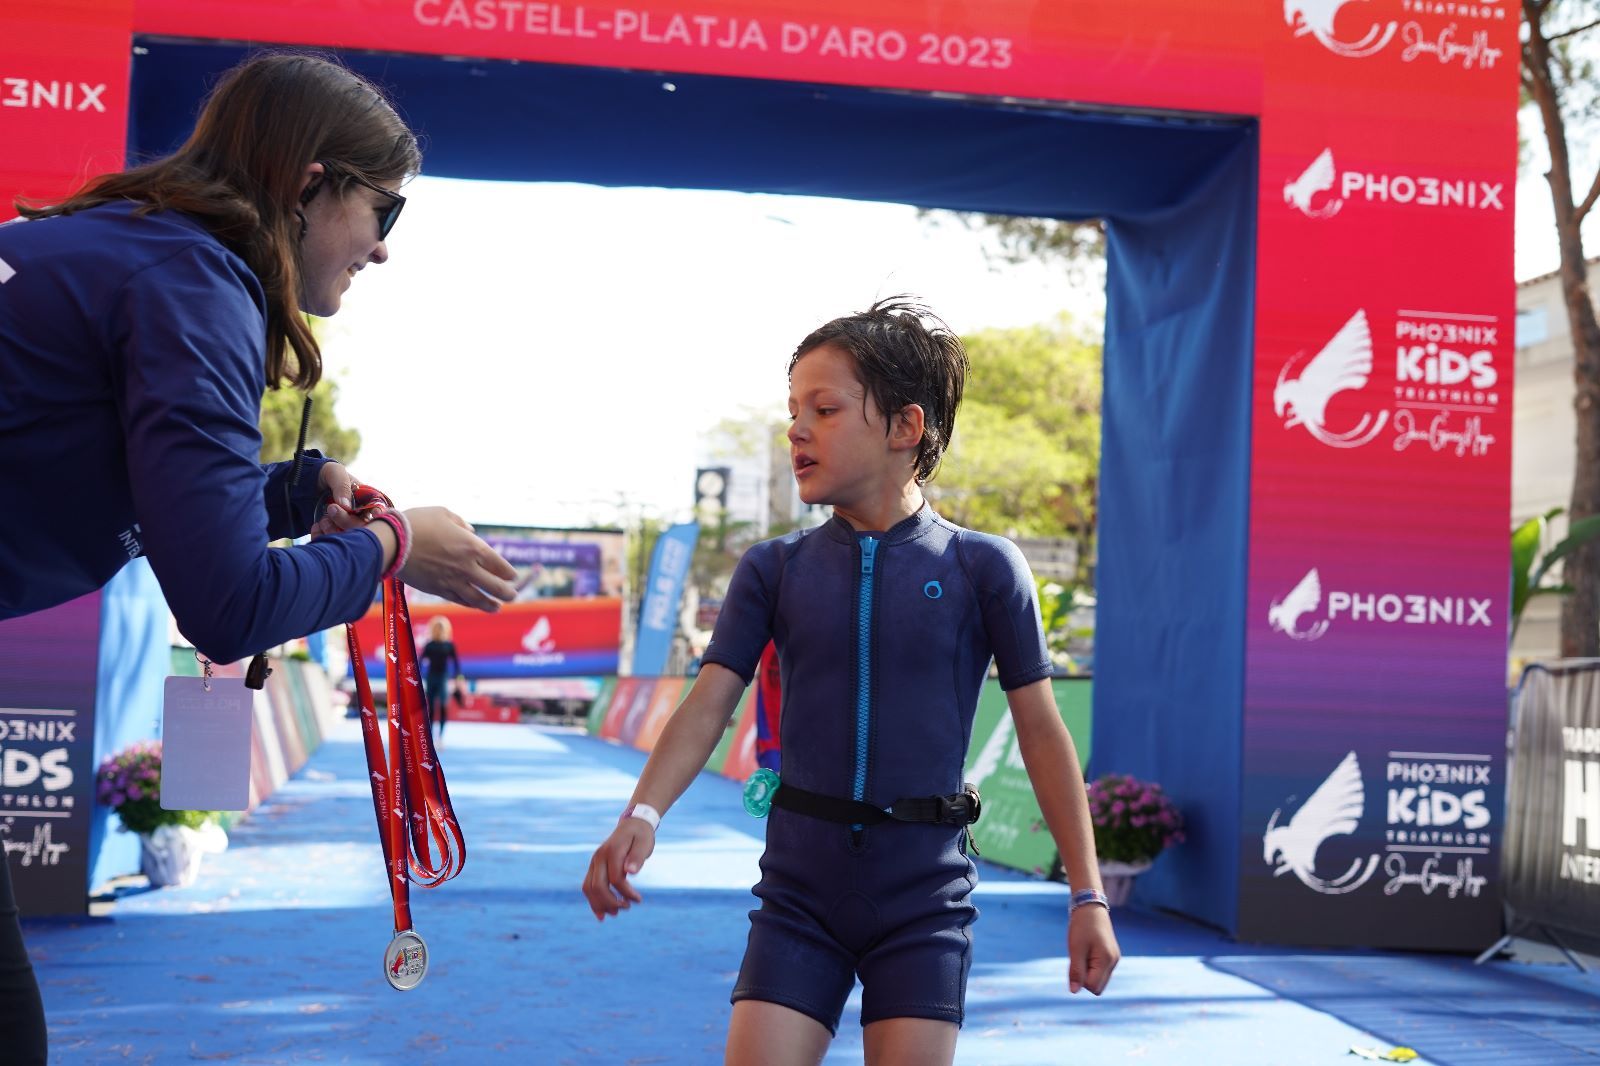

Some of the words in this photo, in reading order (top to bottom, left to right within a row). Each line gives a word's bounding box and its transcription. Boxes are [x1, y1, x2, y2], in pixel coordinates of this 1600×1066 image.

[413, 0, 768, 50] CASTELL-PLATJA
[780, 22, 907, 61] D'ARO
[917, 33, 1013, 69] 2023
[1394, 386, 1499, 405] TRIATHLON
[0, 747, 74, 792] DS
[1385, 829, 1491, 845] TRIATHLON
